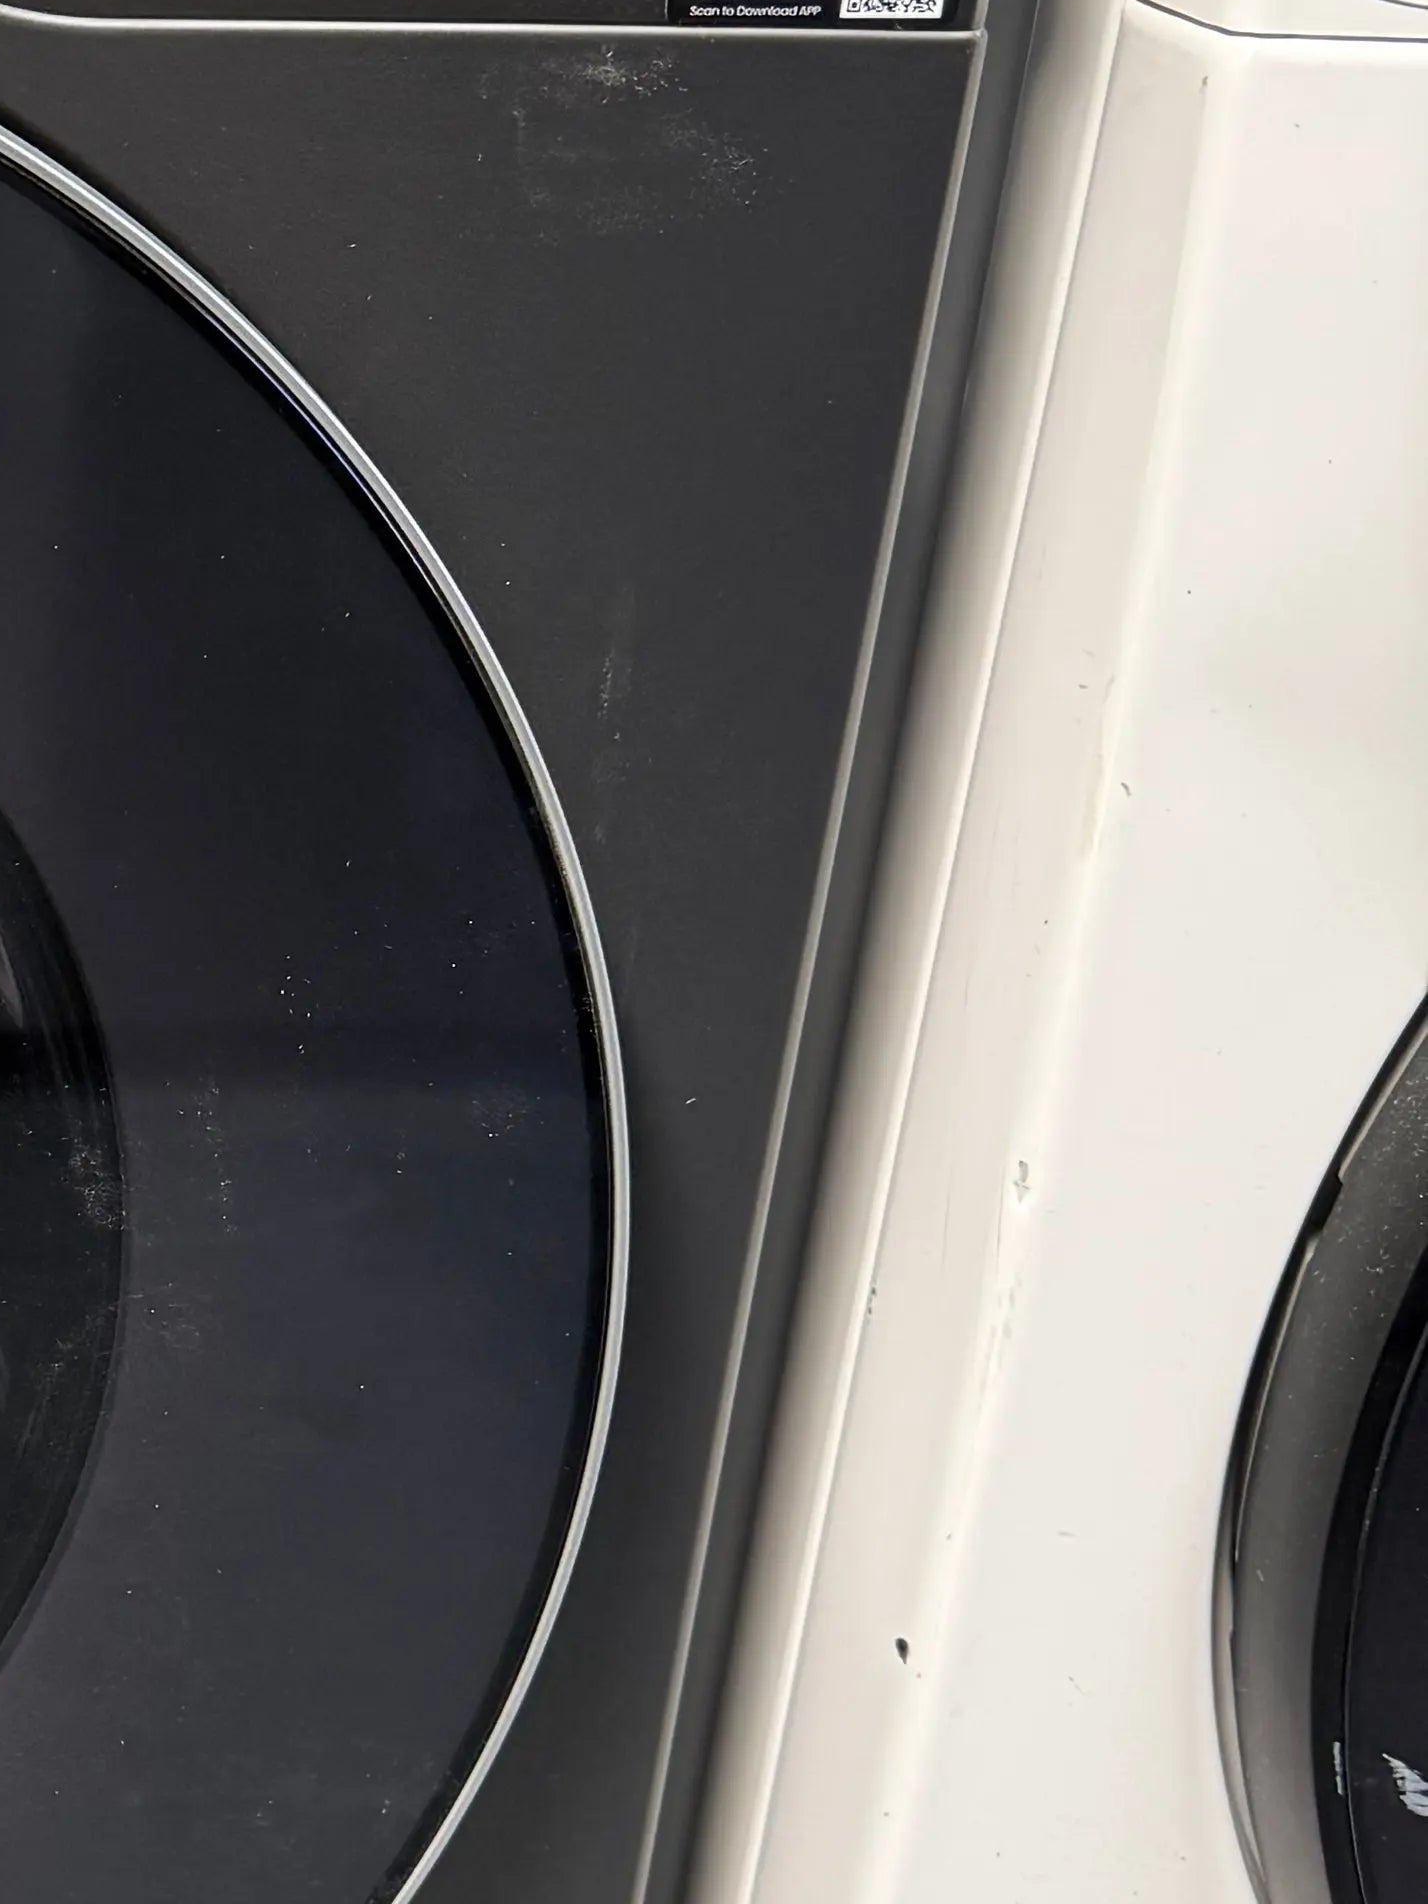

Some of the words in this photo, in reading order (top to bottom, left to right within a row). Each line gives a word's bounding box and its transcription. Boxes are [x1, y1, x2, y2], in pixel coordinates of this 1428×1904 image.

[690, 5, 719, 16] Scan
[722, 6, 733, 16] to
[736, 5, 797, 16] Download
[799, 6, 821, 16] APP
